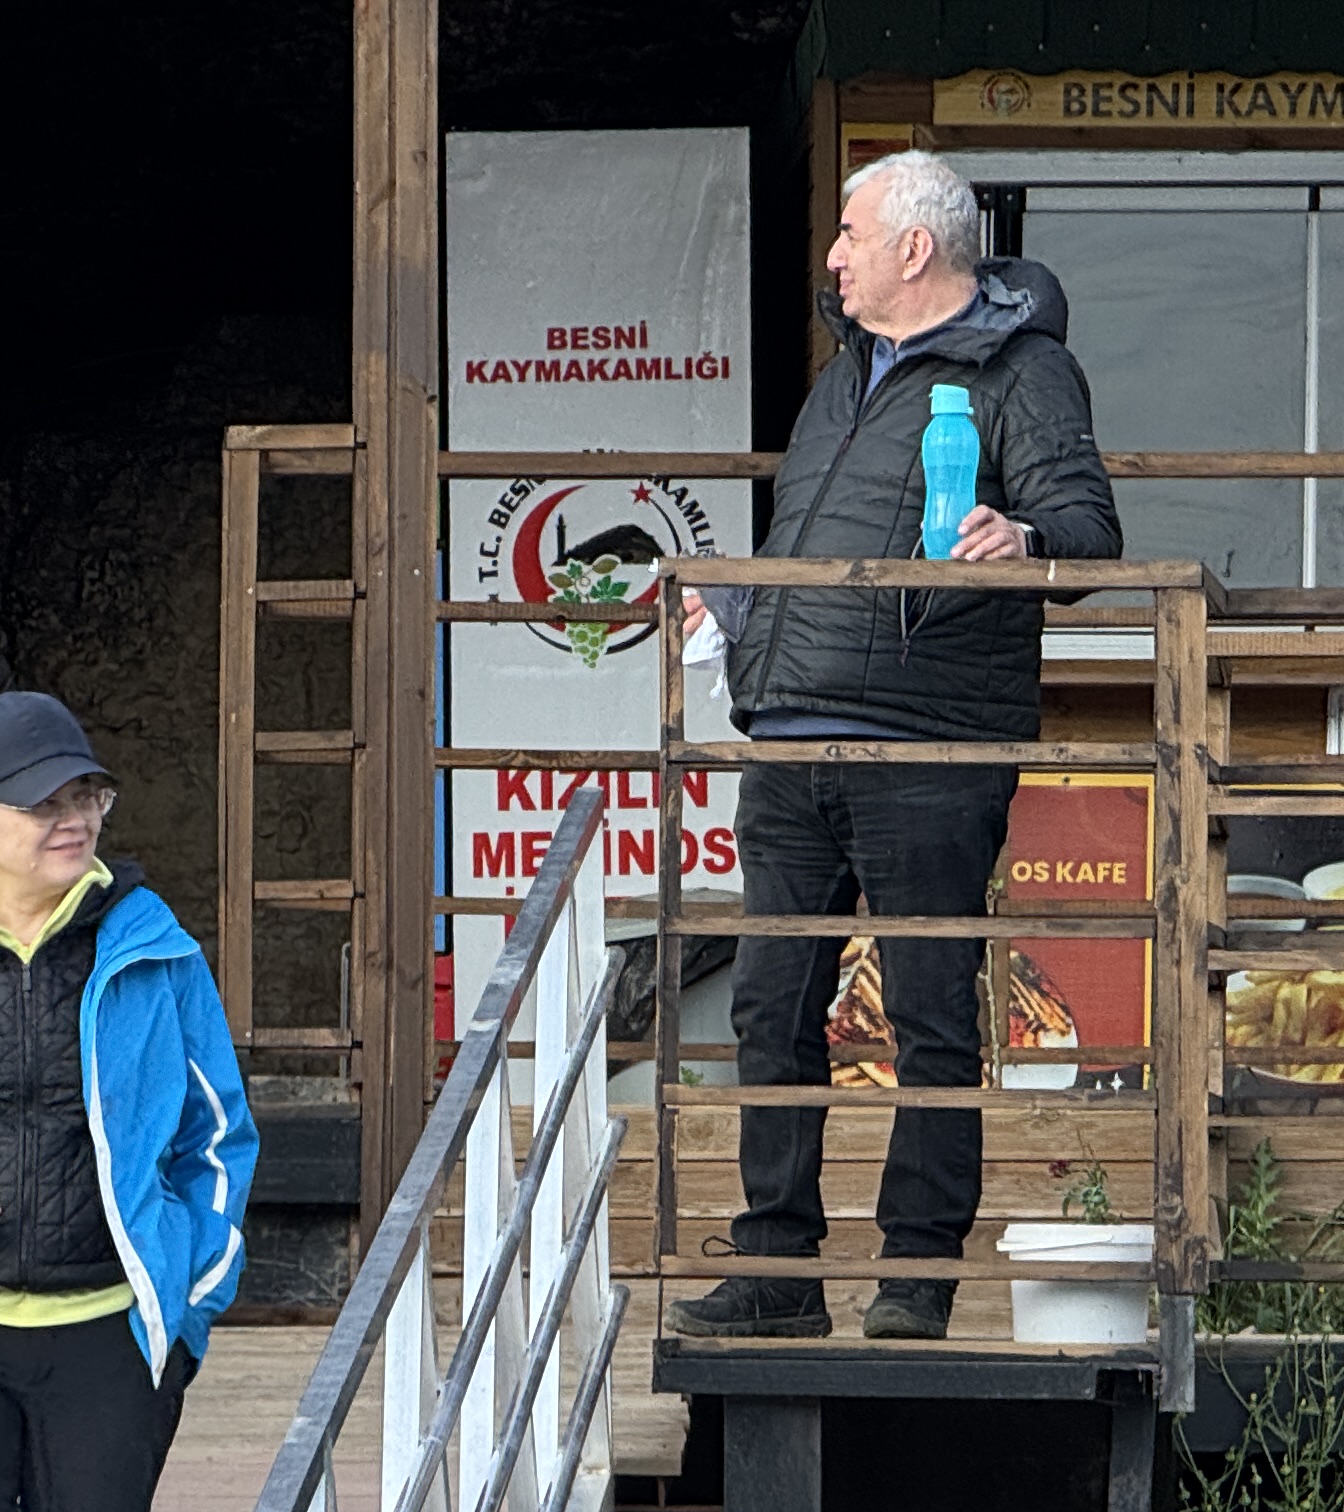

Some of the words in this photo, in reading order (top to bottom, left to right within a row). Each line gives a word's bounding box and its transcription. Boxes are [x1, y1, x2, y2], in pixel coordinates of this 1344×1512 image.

[1062, 71, 1195, 119] BESNİ
[546, 320, 649, 350] BESNİ
[465, 352, 730, 384] KAYMAKAMLIĞI
[1056, 861, 1127, 884] KAFE
